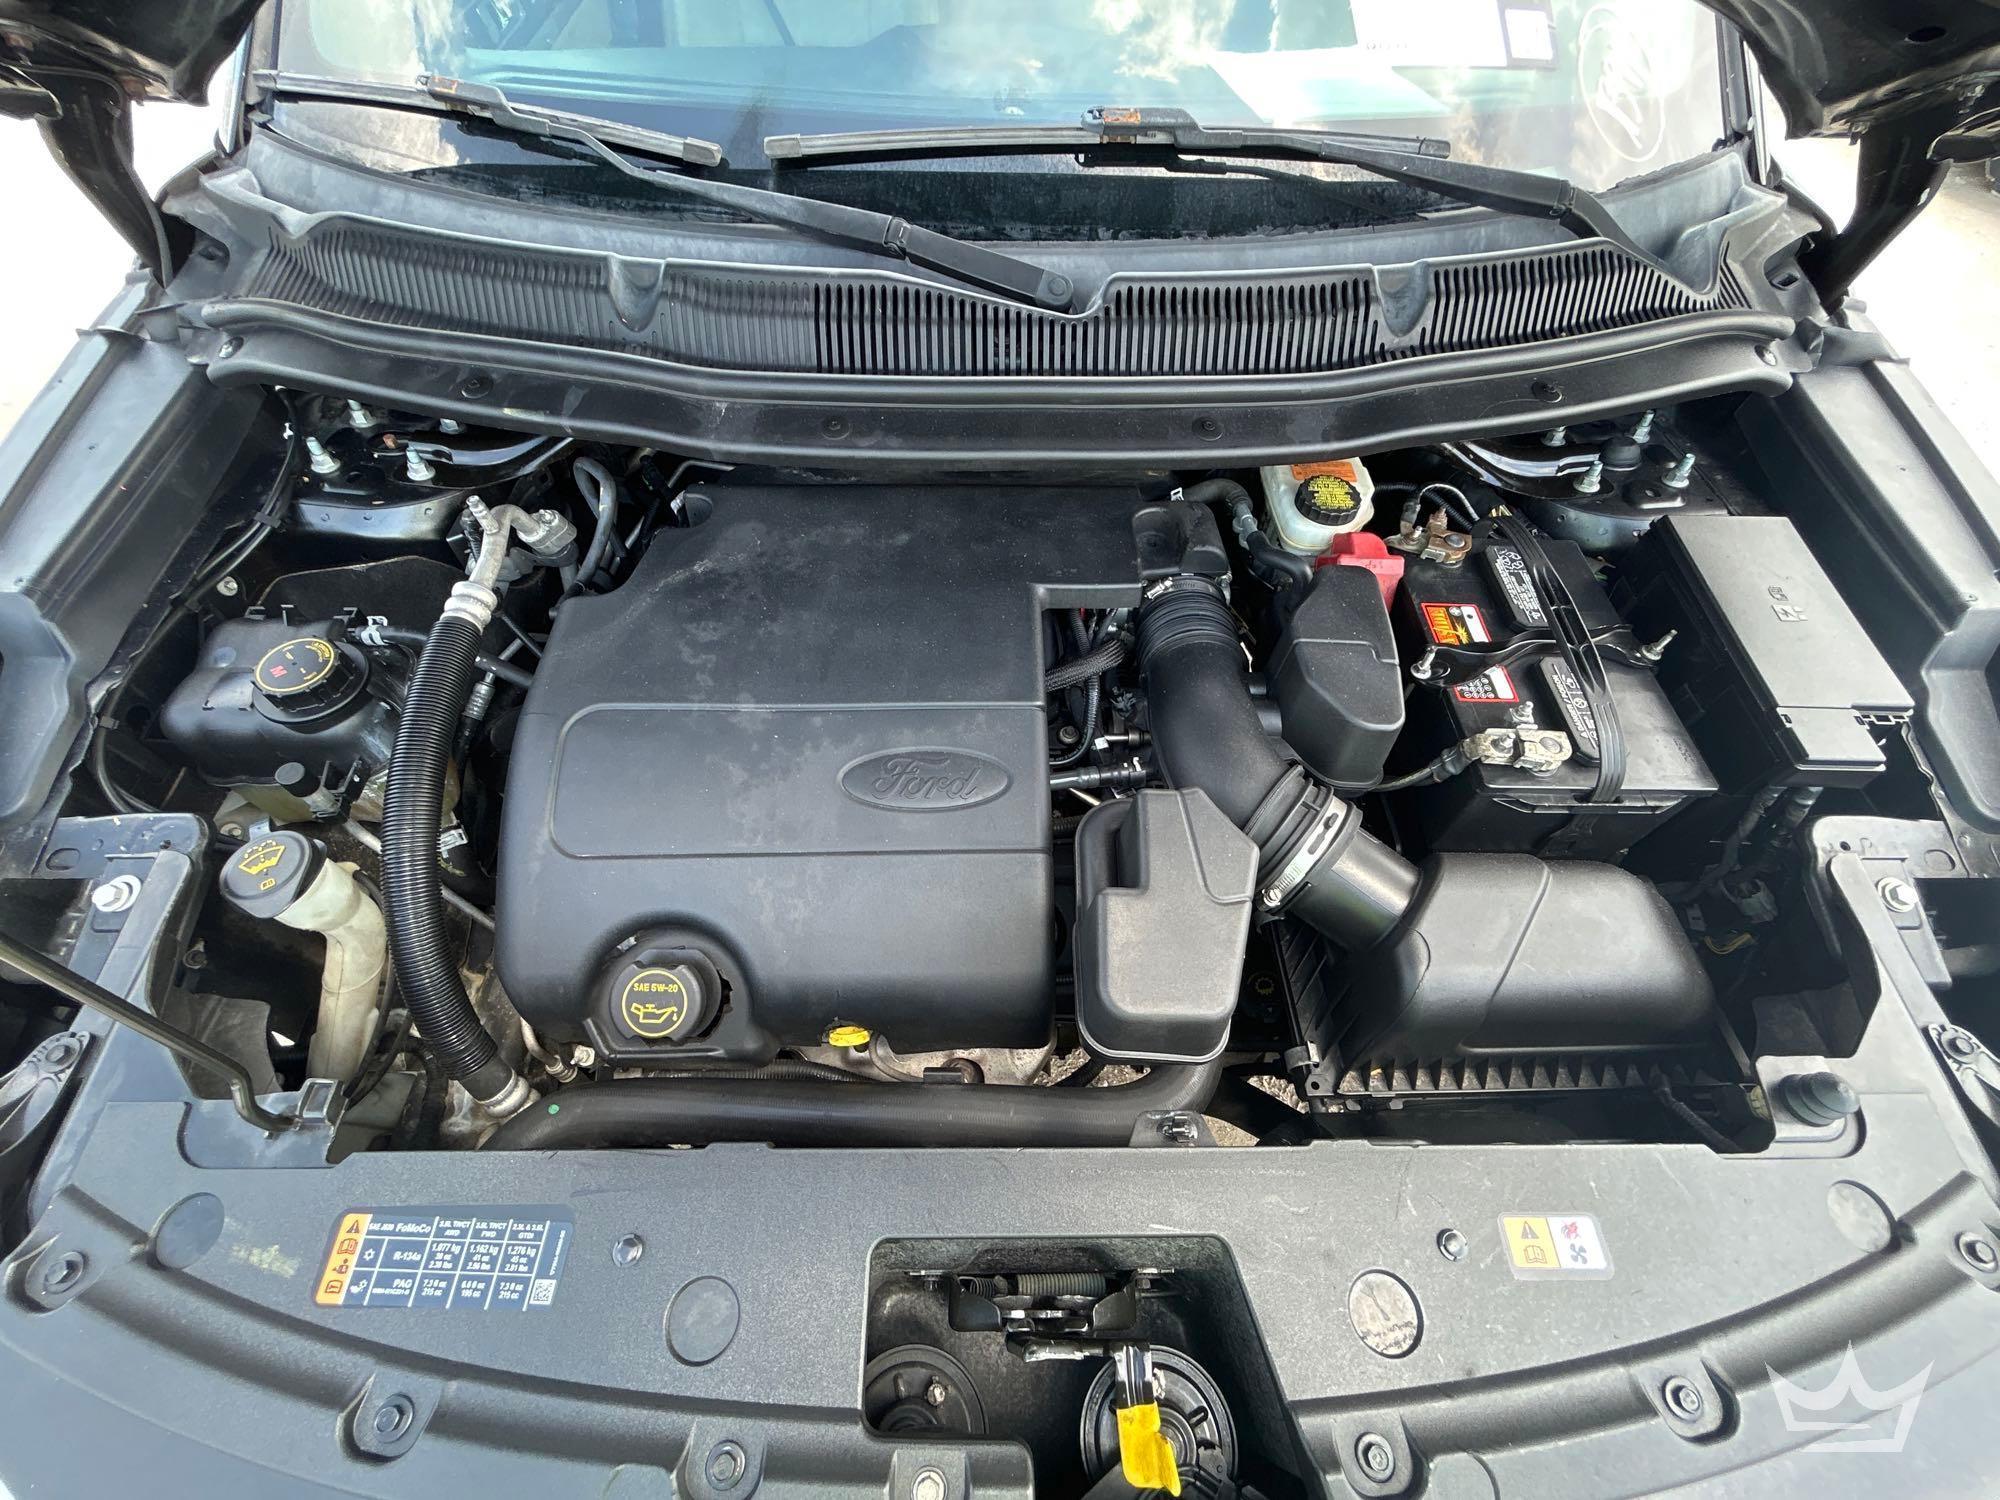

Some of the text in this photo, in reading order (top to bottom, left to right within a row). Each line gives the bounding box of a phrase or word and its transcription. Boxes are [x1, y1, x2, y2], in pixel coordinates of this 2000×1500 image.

[1551, 674, 1569, 698] POISON
[1566, 704, 1585, 731] DANGER
[871, 757, 984, 801] Ford
[633, 982, 678, 993] SAE 5W-20
[396, 1223, 431, 1233] FoMoCo
[451, 1244, 462, 1254] kg
[489, 1245, 499, 1256] kg
[527, 1247, 537, 1257] kg
[393, 1251, 422, 1261] R-134a
[392, 1278, 413, 1288] PAG
[472, 1290, 481, 1298] cc
[498, 1290, 510, 1299] 215
